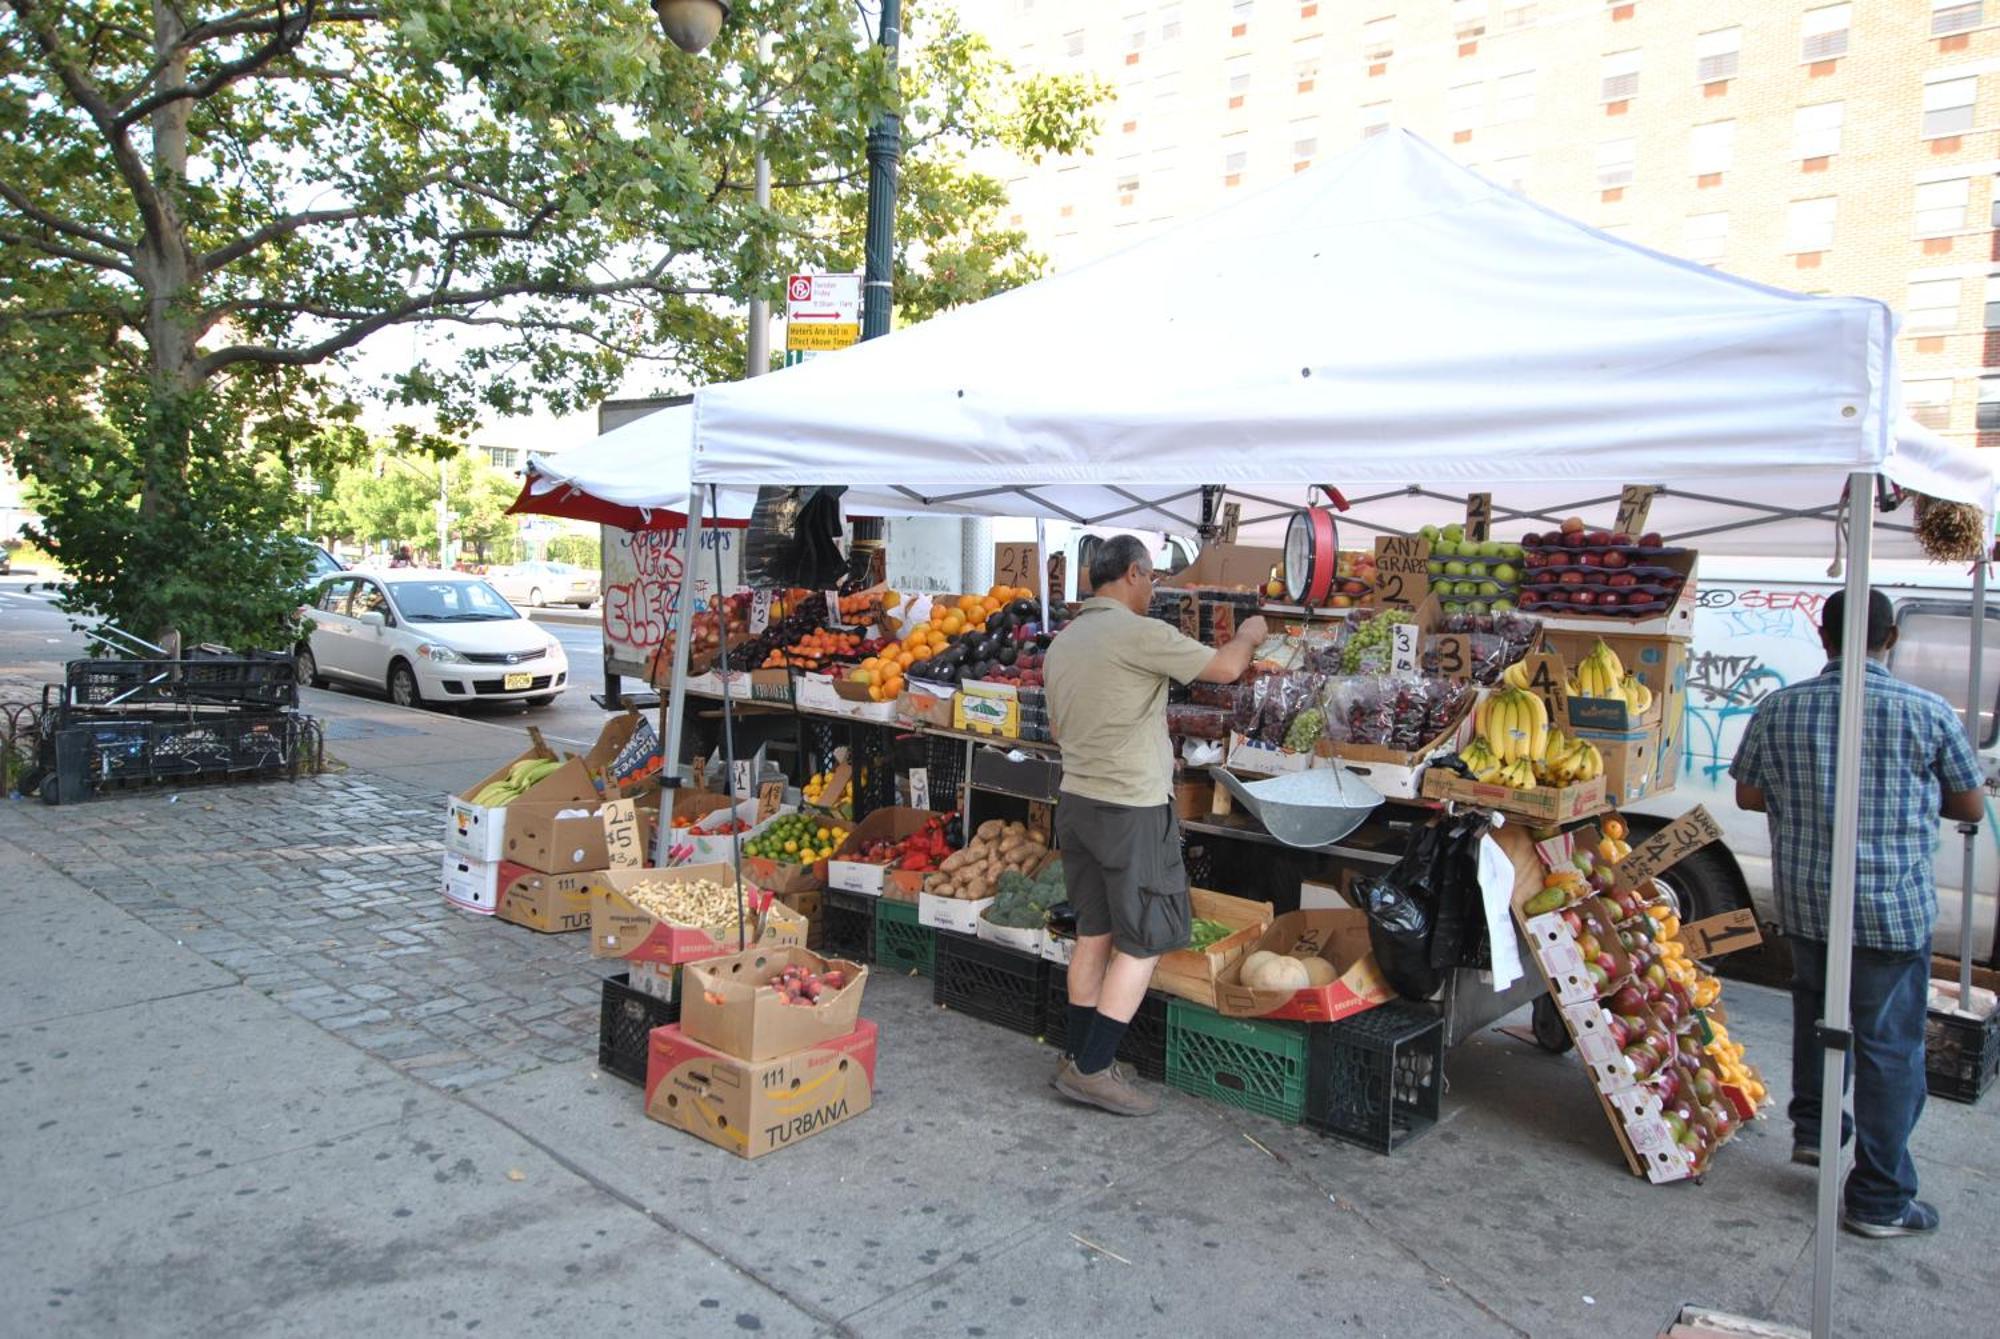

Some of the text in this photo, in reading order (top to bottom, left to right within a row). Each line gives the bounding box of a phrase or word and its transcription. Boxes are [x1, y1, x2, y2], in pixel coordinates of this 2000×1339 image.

[790, 327, 813, 336] Meters
[815, 327, 826, 336] Are
[828, 327, 840, 336] Not
[790, 336, 809, 345] Effect
[811, 337, 831, 346] Above
[1469, 494, 1485, 517] 2
[1383, 536, 1420, 557] ANY
[1001, 547, 1015, 572] 2
[1375, 573, 1410, 604] $2
[1178, 595, 1197, 615] 2
[1529, 661, 1558, 695] 4
[607, 804, 623, 826] 2
[606, 827, 632, 848] $5
[1673, 822, 1699, 845] 3
[762, 1067, 784, 1089] 111
[764, 1098, 850, 1149] TURBANA
